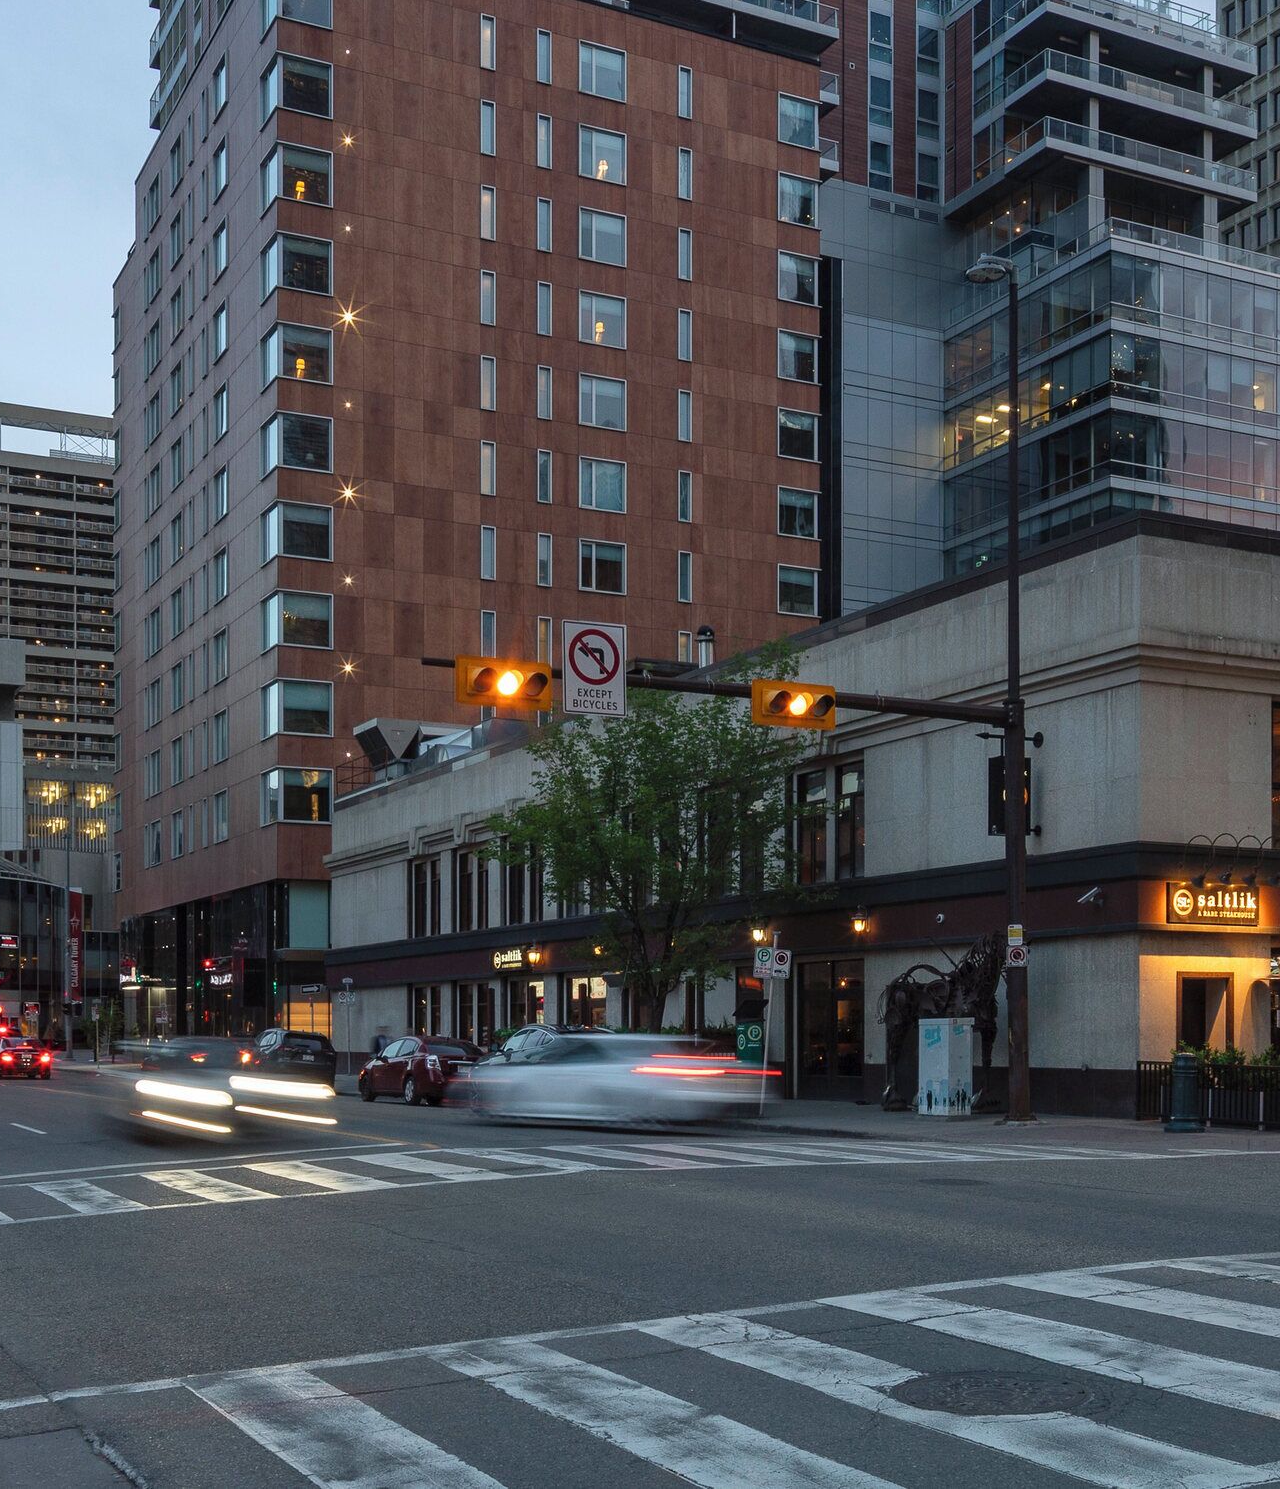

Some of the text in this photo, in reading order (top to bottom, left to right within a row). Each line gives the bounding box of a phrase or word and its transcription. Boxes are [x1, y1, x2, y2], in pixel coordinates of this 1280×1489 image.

[577, 688, 613, 699] EXCEPT
[572, 699, 618, 711] BICYCLES
[1197, 890, 1257, 909] saltlik
[71, 937, 79, 988] CALGARY TOWER
[501, 949, 522, 963] saltlik
